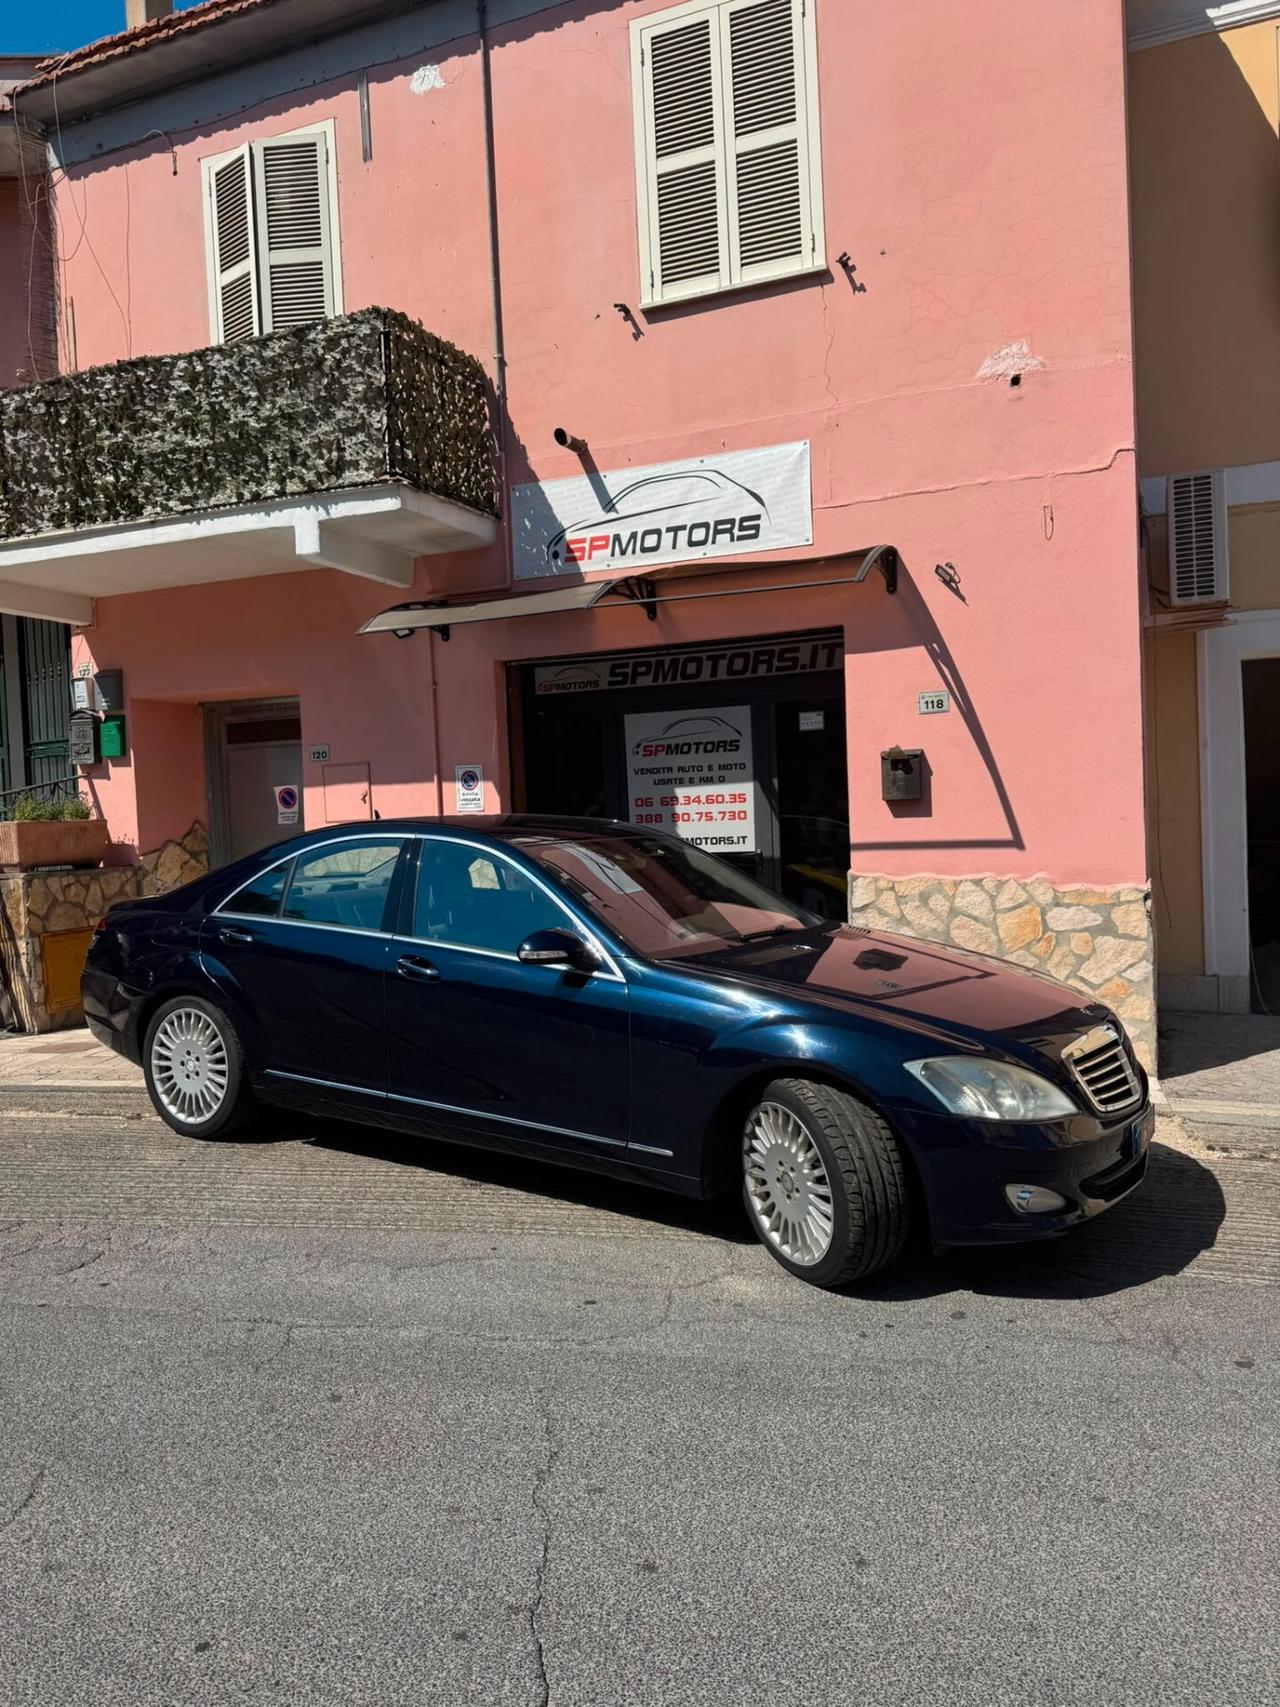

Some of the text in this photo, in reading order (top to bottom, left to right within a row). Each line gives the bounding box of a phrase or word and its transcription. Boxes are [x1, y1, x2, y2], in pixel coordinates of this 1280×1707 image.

[564, 514, 761, 562] SPMOTORS
[608, 643, 843, 687] SPMOTORS.IT
[924, 699, 944, 709] 118
[312, 750, 327, 759] 120
[642, 739, 741, 757] SPMOTORS
[633, 766, 673, 775] VENDITA
[677, 764, 703, 773] AUTO
[718, 763, 746, 771] MOTO
[653, 777, 684, 786] USATE
[688, 776, 695, 784] E
[699, 775, 714, 783] KM
[635, 793, 747, 807] 06 69.34.60.35
[635, 810, 747, 824] 388 90.75.730
[681, 836, 748, 846] MOTORS.IT
